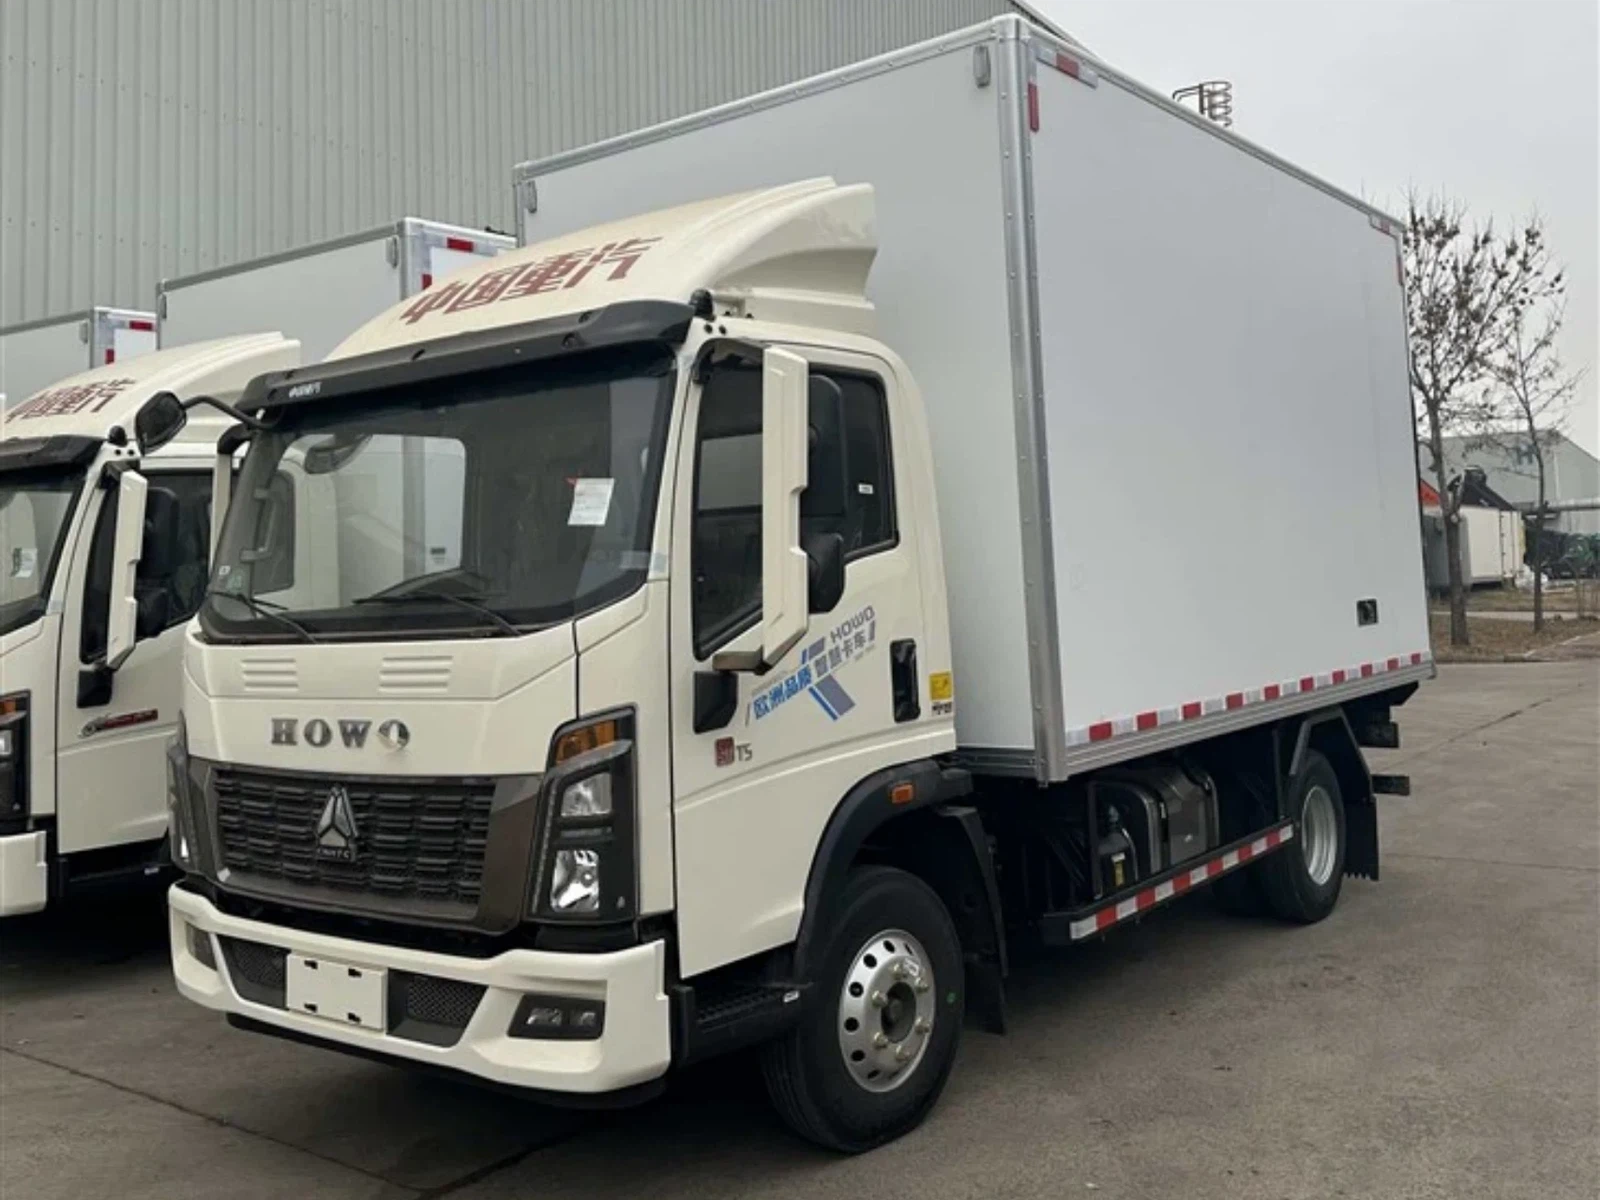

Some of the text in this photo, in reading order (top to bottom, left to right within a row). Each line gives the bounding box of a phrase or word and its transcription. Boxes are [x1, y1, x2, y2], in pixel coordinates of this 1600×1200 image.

[399, 236, 664, 326] 中国重汽
[830, 605, 875, 643] HOWO
[271, 717, 410, 750] HOWO
